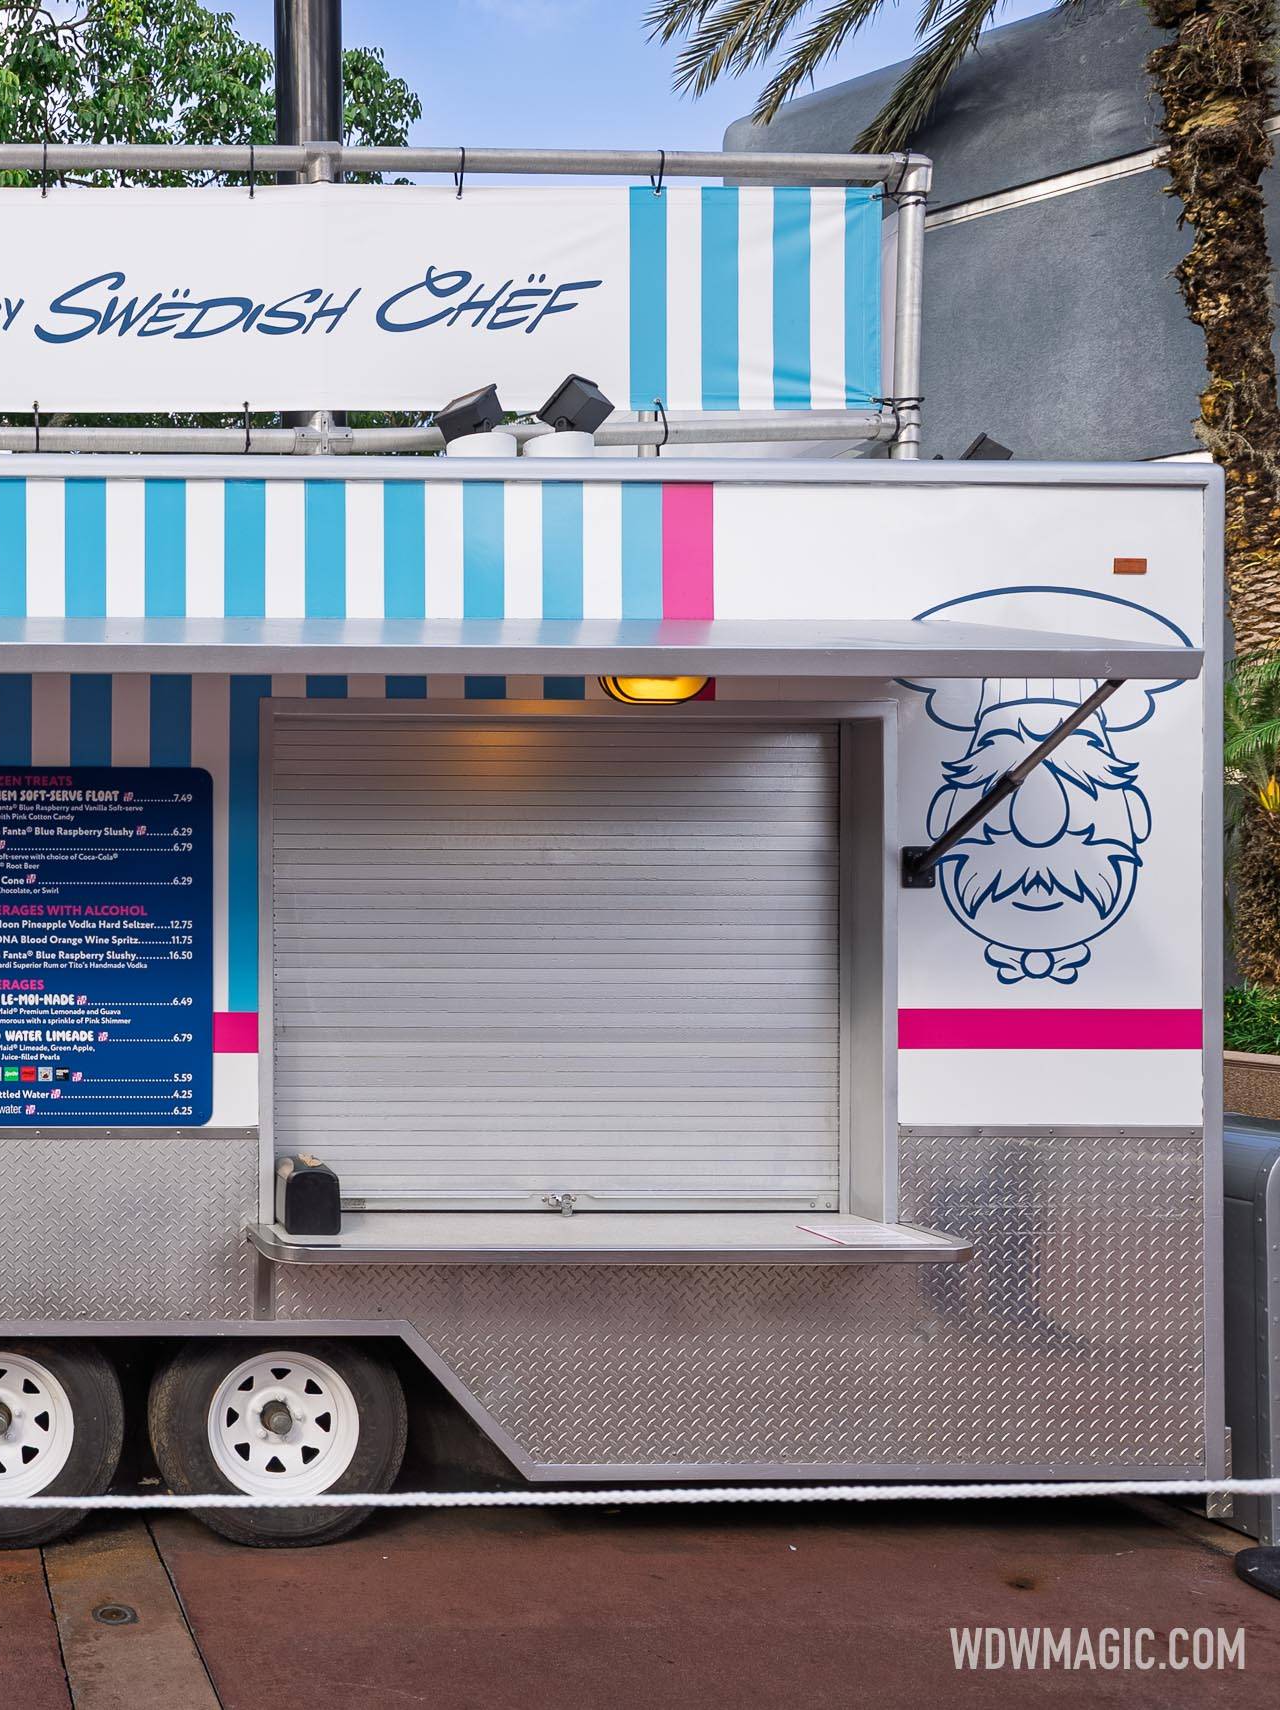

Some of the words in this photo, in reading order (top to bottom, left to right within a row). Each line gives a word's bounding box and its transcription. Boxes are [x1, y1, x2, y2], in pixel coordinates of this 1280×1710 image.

[25, 776, 73, 786] TREATS
[20, 790, 82, 801] SOFT-SERVE
[86, 790, 119, 801] FLOAT
[53, 813, 74, 821] Candy
[34, 827, 54, 835] Blue
[57, 827, 102, 837] Raspberry
[104, 827, 134, 837] Slushy
[1, 876, 24, 885] Cone
[47, 905, 82, 916] WITH
[84, 905, 148, 916] ALCOHOL
[22, 921, 66, 930] Pineapple
[68, 921, 96, 929] Vodka
[99, 921, 120, 929] Hard
[20, 935, 47, 944] Blood
[49, 935, 82, 946] Orange
[84, 935, 109, 944] Wine
[35, 951, 55, 959] Blue
[58, 951, 104, 961] Raspberry
[106, 951, 136, 961] Slushy
[1, 994, 75, 1005] LE-MOI-NADE
[5, 1030, 42, 1042] WATER
[46, 1030, 94, 1042] LIMEADE
[22, 1090, 50, 1099] Water
